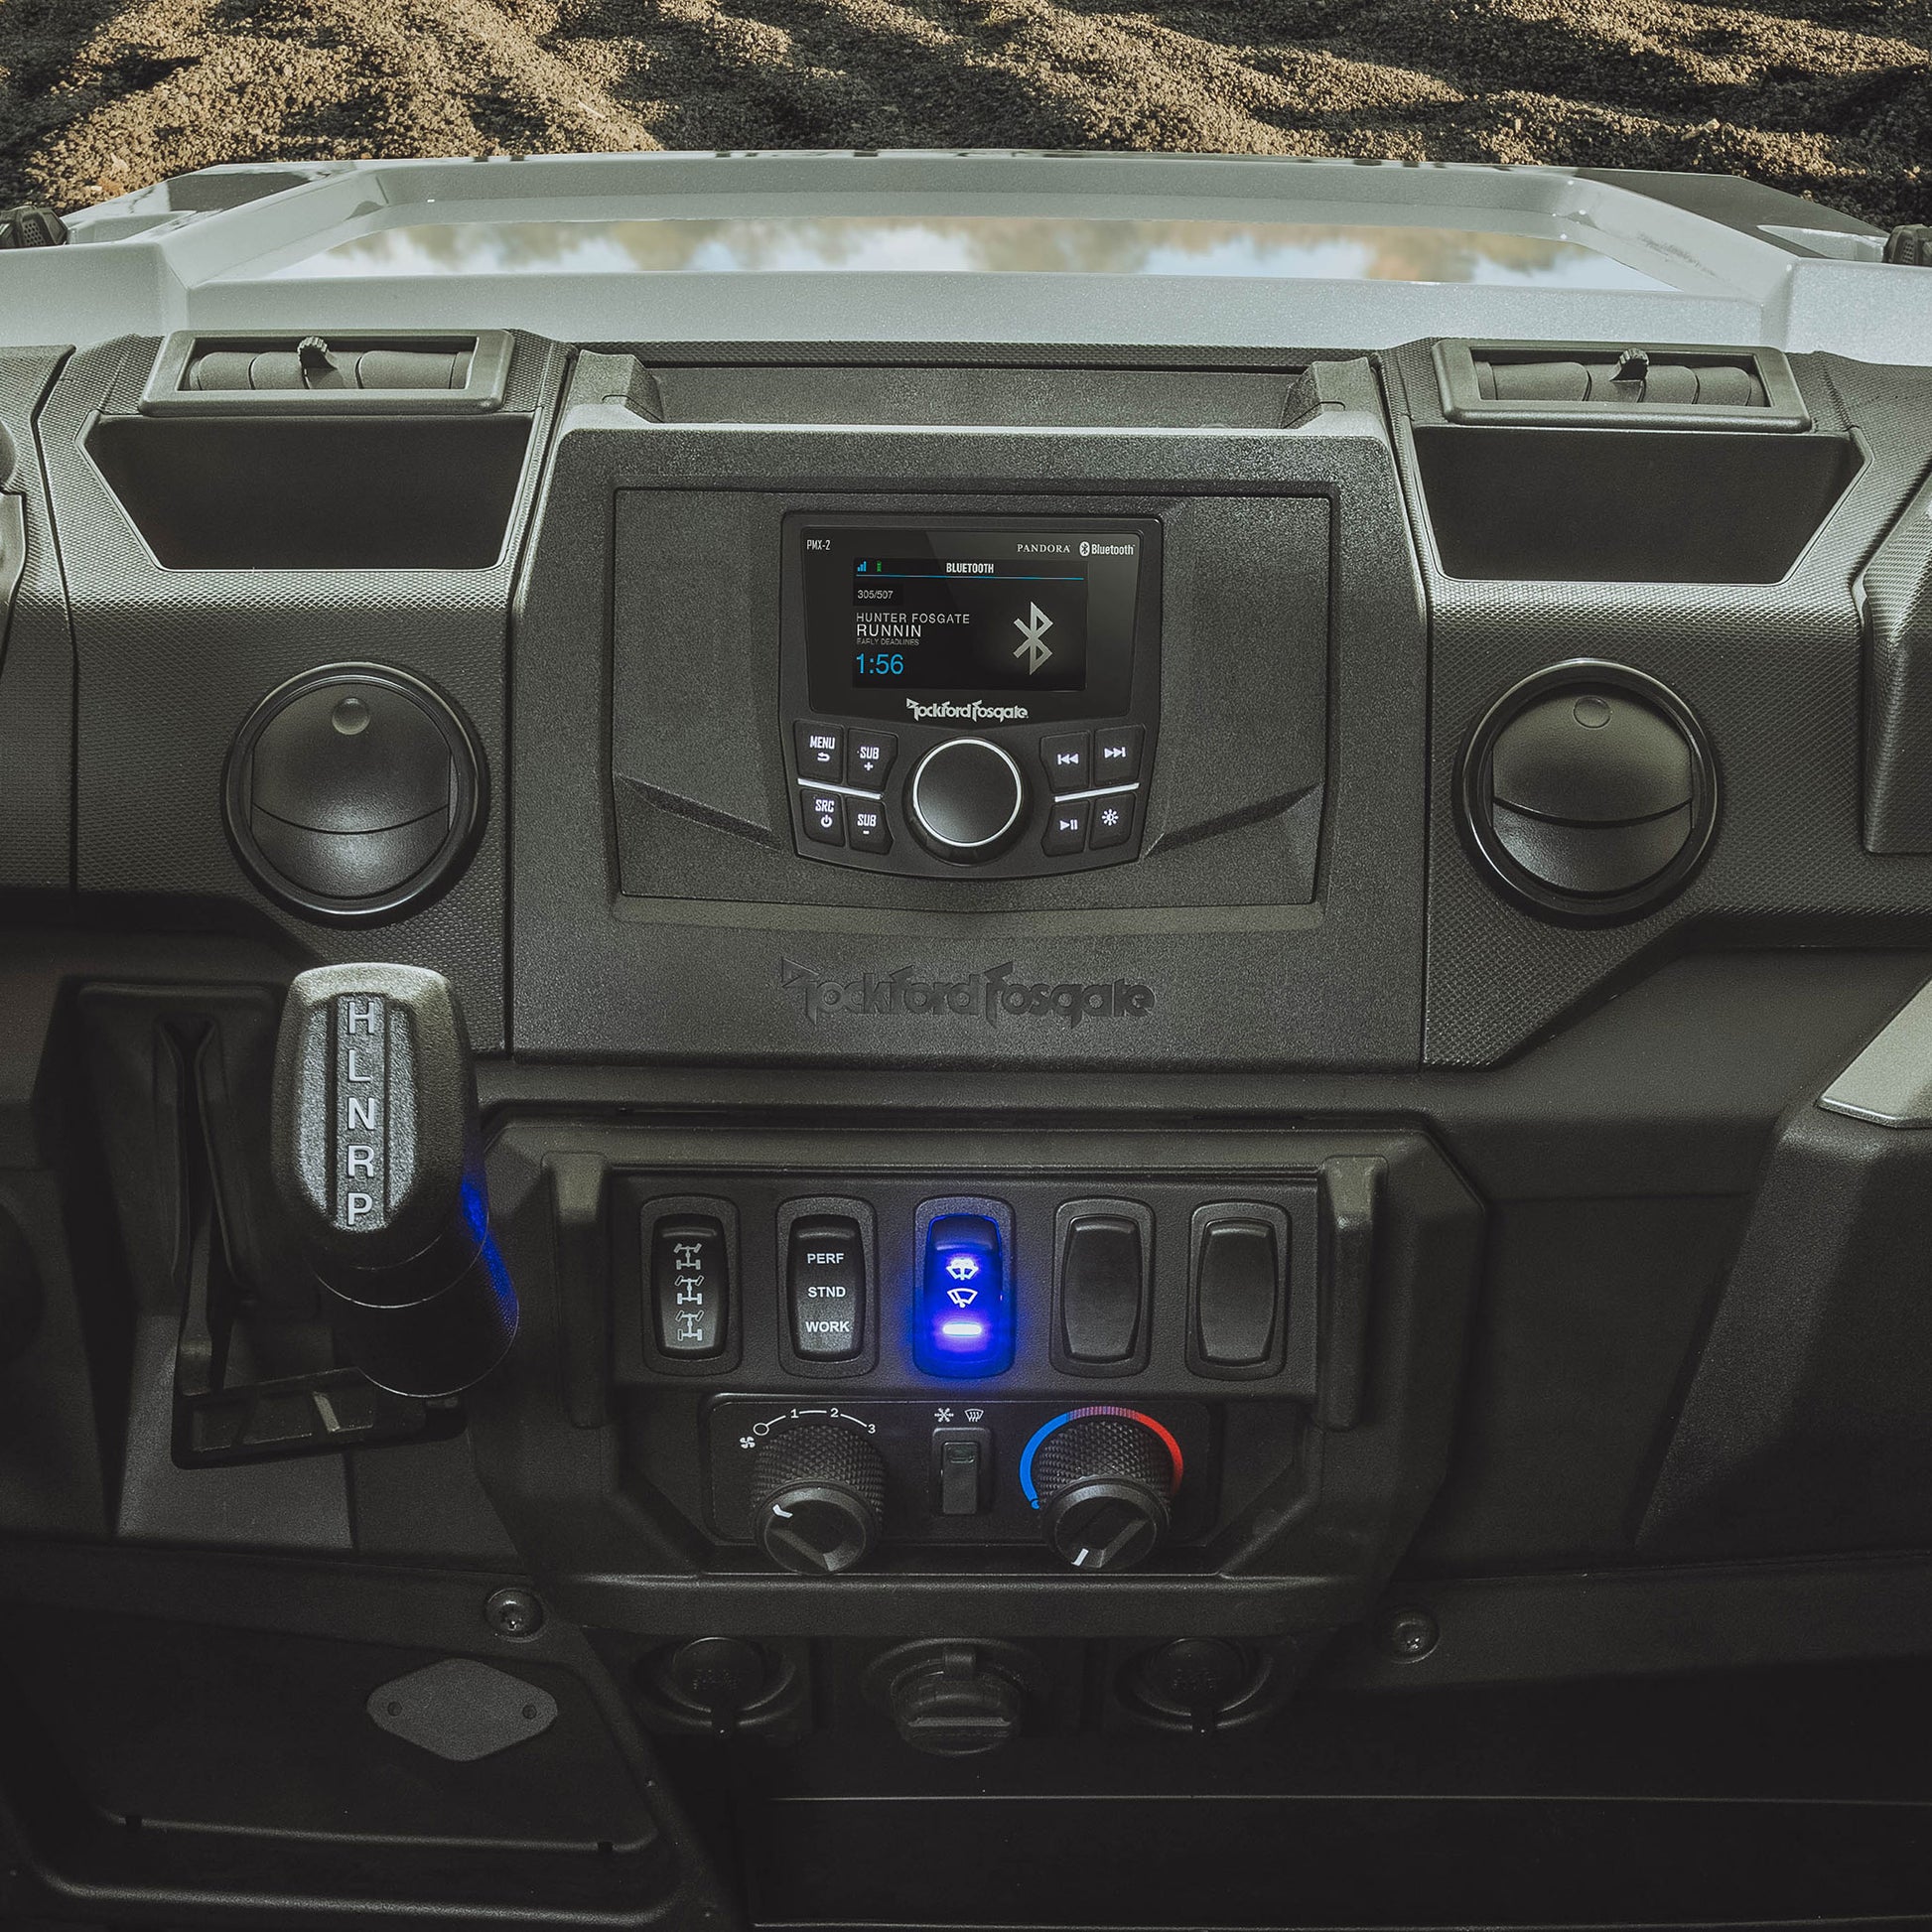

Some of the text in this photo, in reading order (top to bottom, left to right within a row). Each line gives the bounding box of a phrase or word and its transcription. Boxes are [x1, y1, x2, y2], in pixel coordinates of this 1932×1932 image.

[806, 540, 831, 550] PMX-2
[1017, 543, 1071, 553] PANDORA
[1091, 543, 1134, 555] Bluetooth
[946, 563, 994, 574] BLUETOOTH
[857, 590, 894, 600] 305/507
[856, 612, 970, 624] HUNTER FOSGATE
[857, 623, 922, 637] RUNNIN
[856, 652, 904, 675] 1:56
[809, 736, 836, 750] MENU
[860, 747, 880, 760] SUB
[815, 799, 835, 813] SRC
[857, 813, 877, 827] SUB
[806, 1253, 845, 1265] PERF
[807, 1286, 846, 1299] STND
[805, 1320, 850, 1333] WORK
[790, 1407, 839, 1419] 1 2
[867, 1424, 876, 1435] 3
